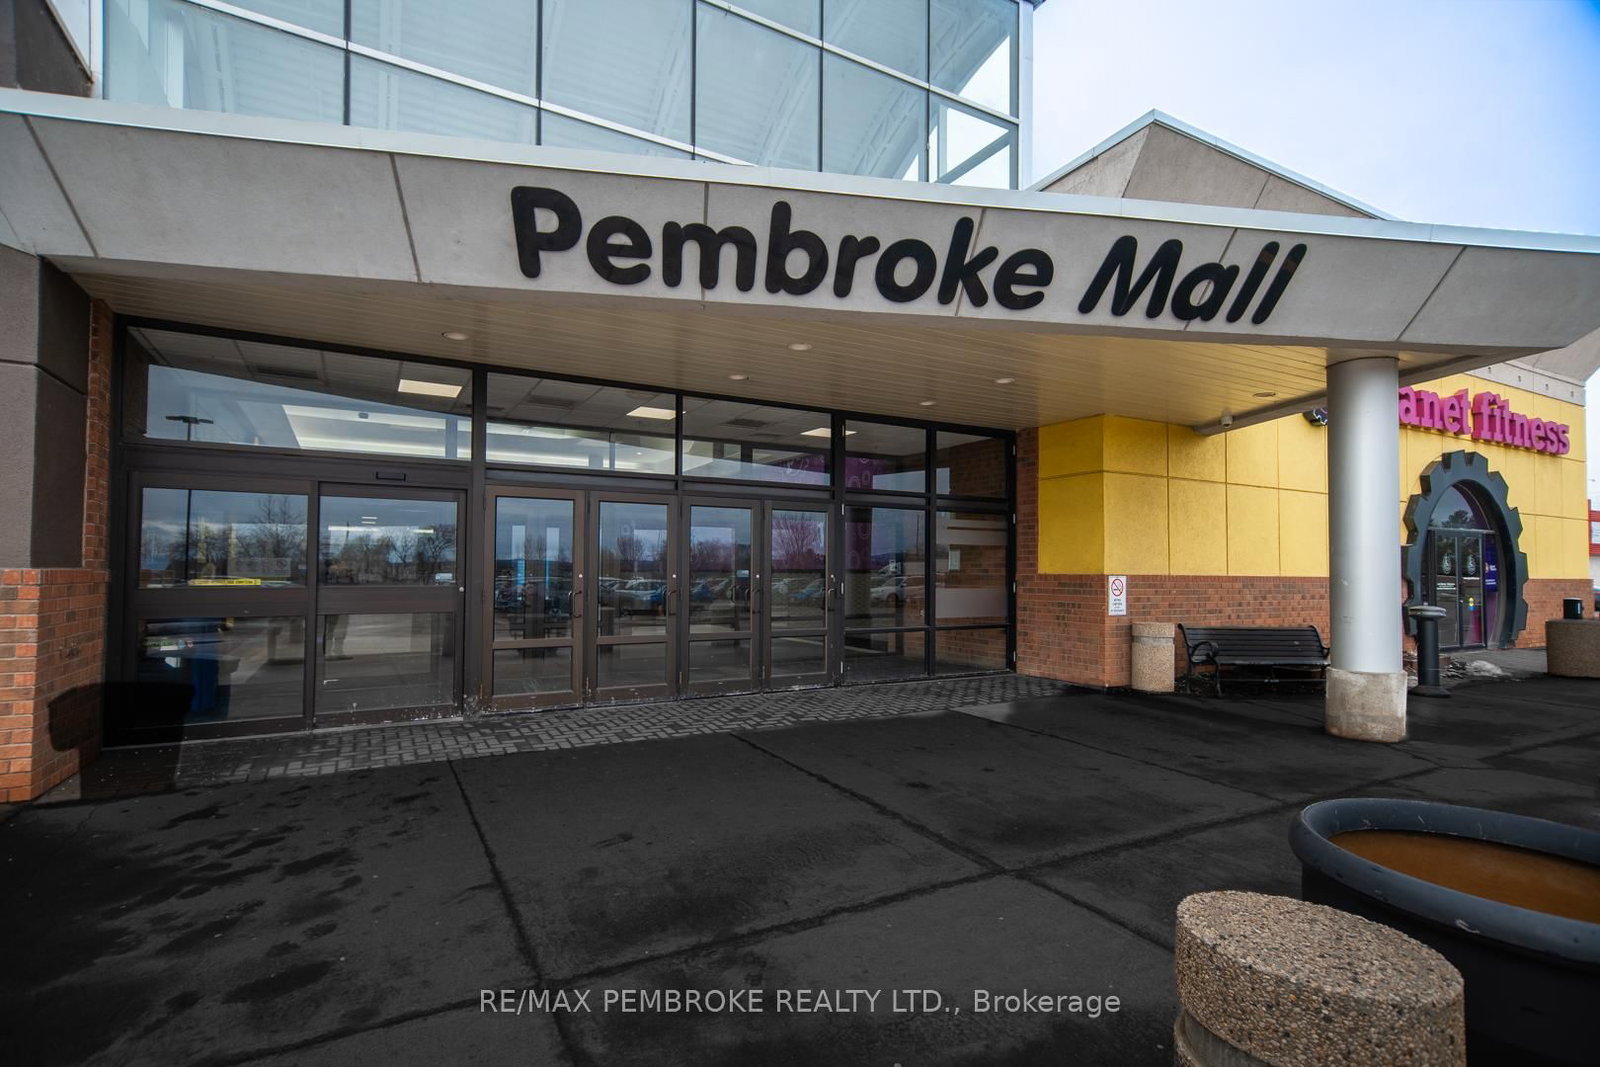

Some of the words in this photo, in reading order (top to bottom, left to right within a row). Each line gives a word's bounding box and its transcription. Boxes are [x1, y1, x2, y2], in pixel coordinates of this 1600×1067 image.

[510, 185, 1054, 311] Pembroke
[1077, 234, 1308, 325] Mall
[1399, 386, 1472, 435] anet
[1471, 391, 1570, 455] fitness
